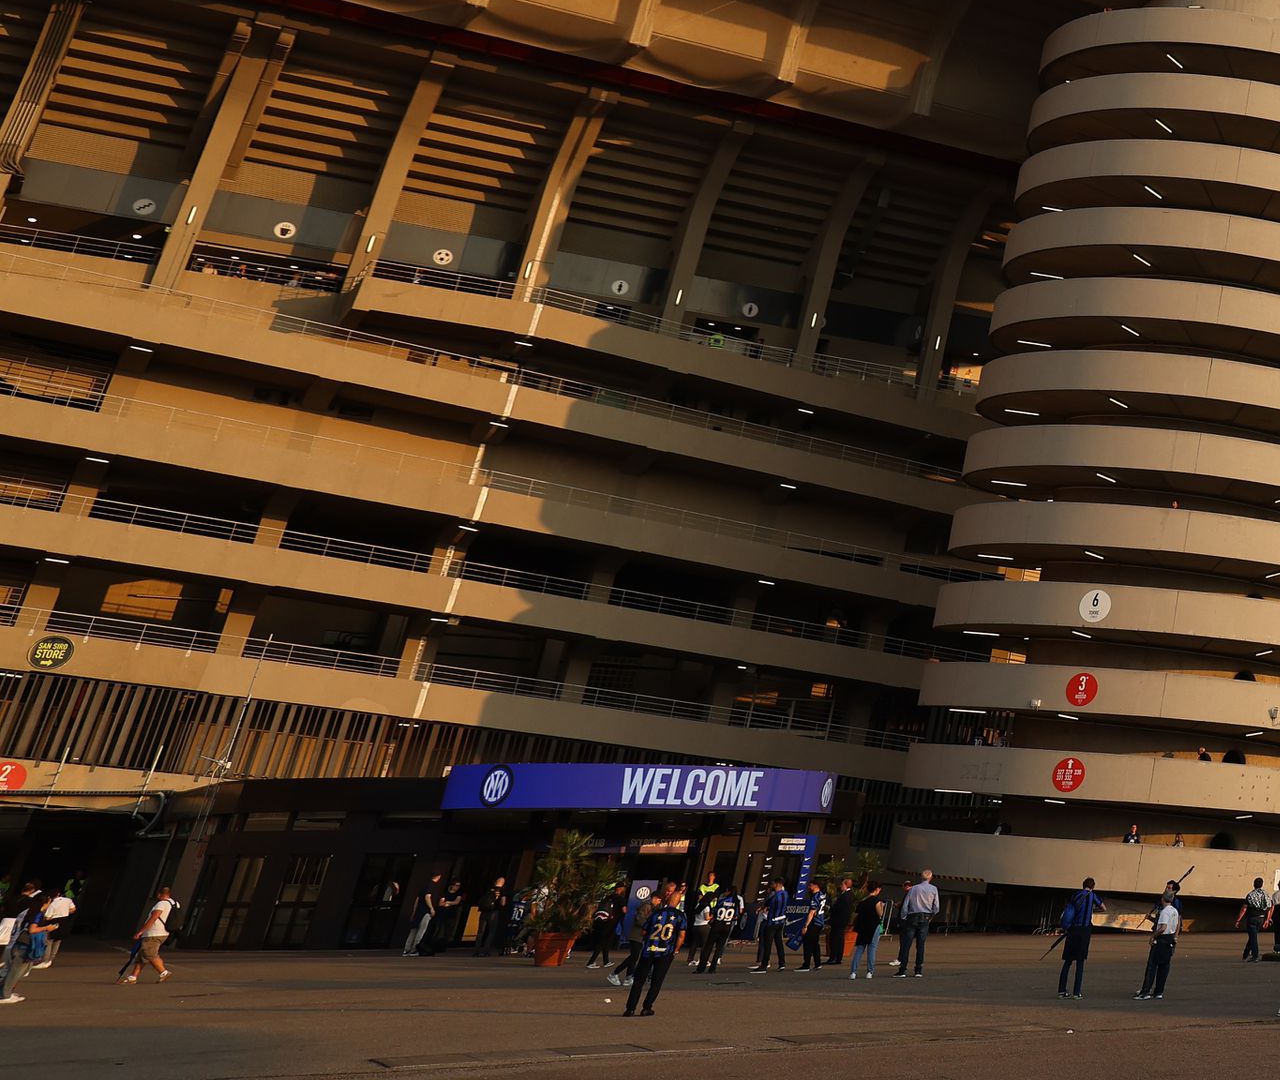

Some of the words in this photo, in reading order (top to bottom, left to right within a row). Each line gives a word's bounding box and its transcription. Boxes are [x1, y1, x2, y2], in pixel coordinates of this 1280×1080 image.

[1092, 593, 1099, 607] 6
[38, 642, 52, 650] SAN
[35, 650, 66, 660] STORE
[621, 767, 764, 807] WELCOME
[716, 907, 736, 922] 99
[650, 923, 674, 941] 20
